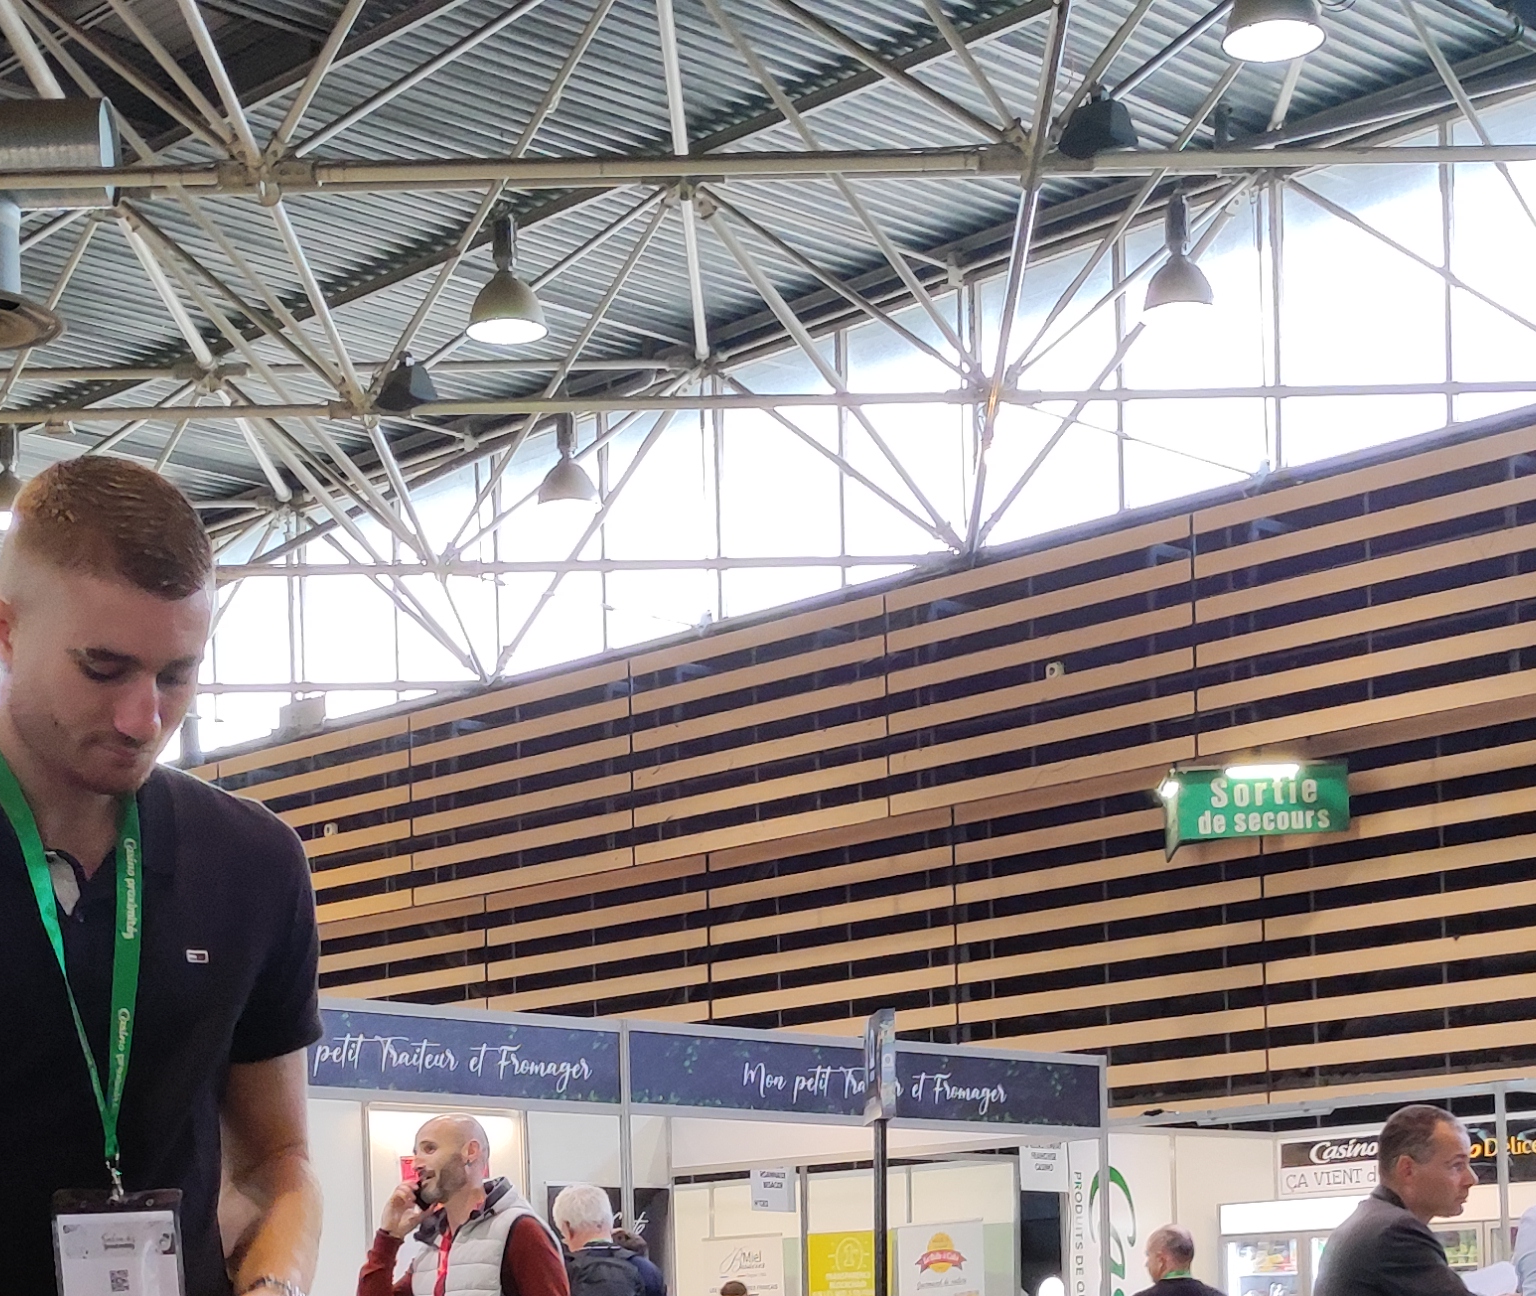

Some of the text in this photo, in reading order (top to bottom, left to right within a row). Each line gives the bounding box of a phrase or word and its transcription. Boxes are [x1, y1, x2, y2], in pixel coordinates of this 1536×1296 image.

[1210, 777, 1318, 808] Sortie
[1197, 808, 1331, 835] de secours
[313, 1033, 593, 1093] petit Traiteur et Fromager
[742, 1062, 787, 1098] Mon
[792, 1065, 832, 1104] petit
[911, 1072, 934, 1100] et
[933, 1073, 1008, 1114] Fromager
[1309, 1137, 1379, 1165] Casino
[1286, 1168, 1309, 1192] ÇA
[1314, 1167, 1363, 1186] VIENT
[1073, 1171, 1085, 1251] PRODUITS
[1075, 1256, 1085, 1276] DE
